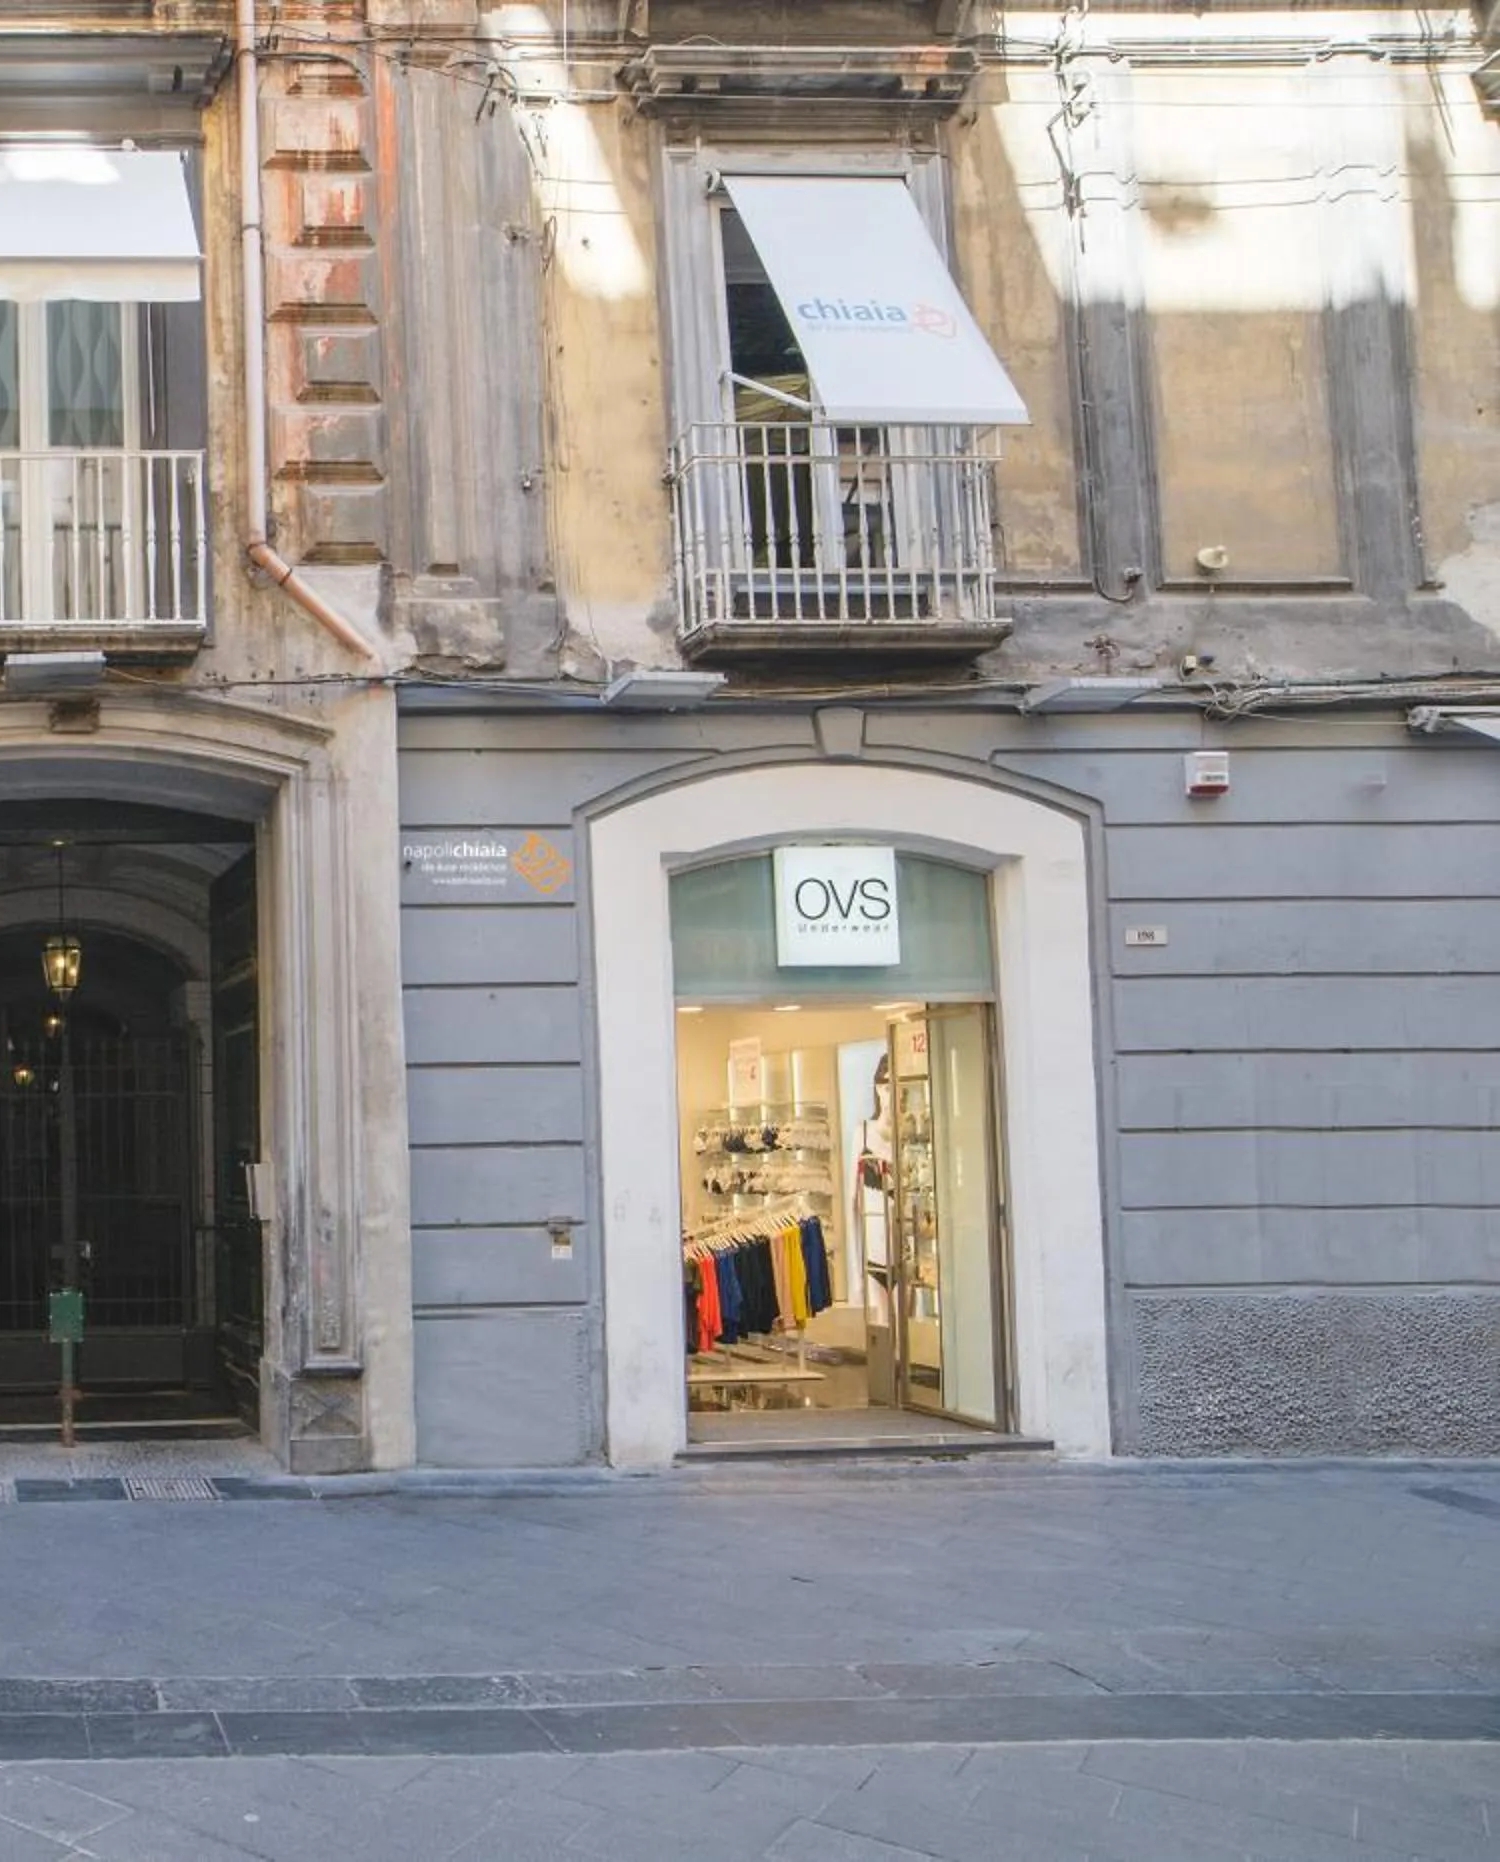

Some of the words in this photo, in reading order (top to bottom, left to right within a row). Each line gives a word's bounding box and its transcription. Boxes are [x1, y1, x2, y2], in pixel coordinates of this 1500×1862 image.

[797, 298, 906, 321] chiaia
[403, 840, 507, 860] napolichiaia
[795, 878, 890, 920] OVS
